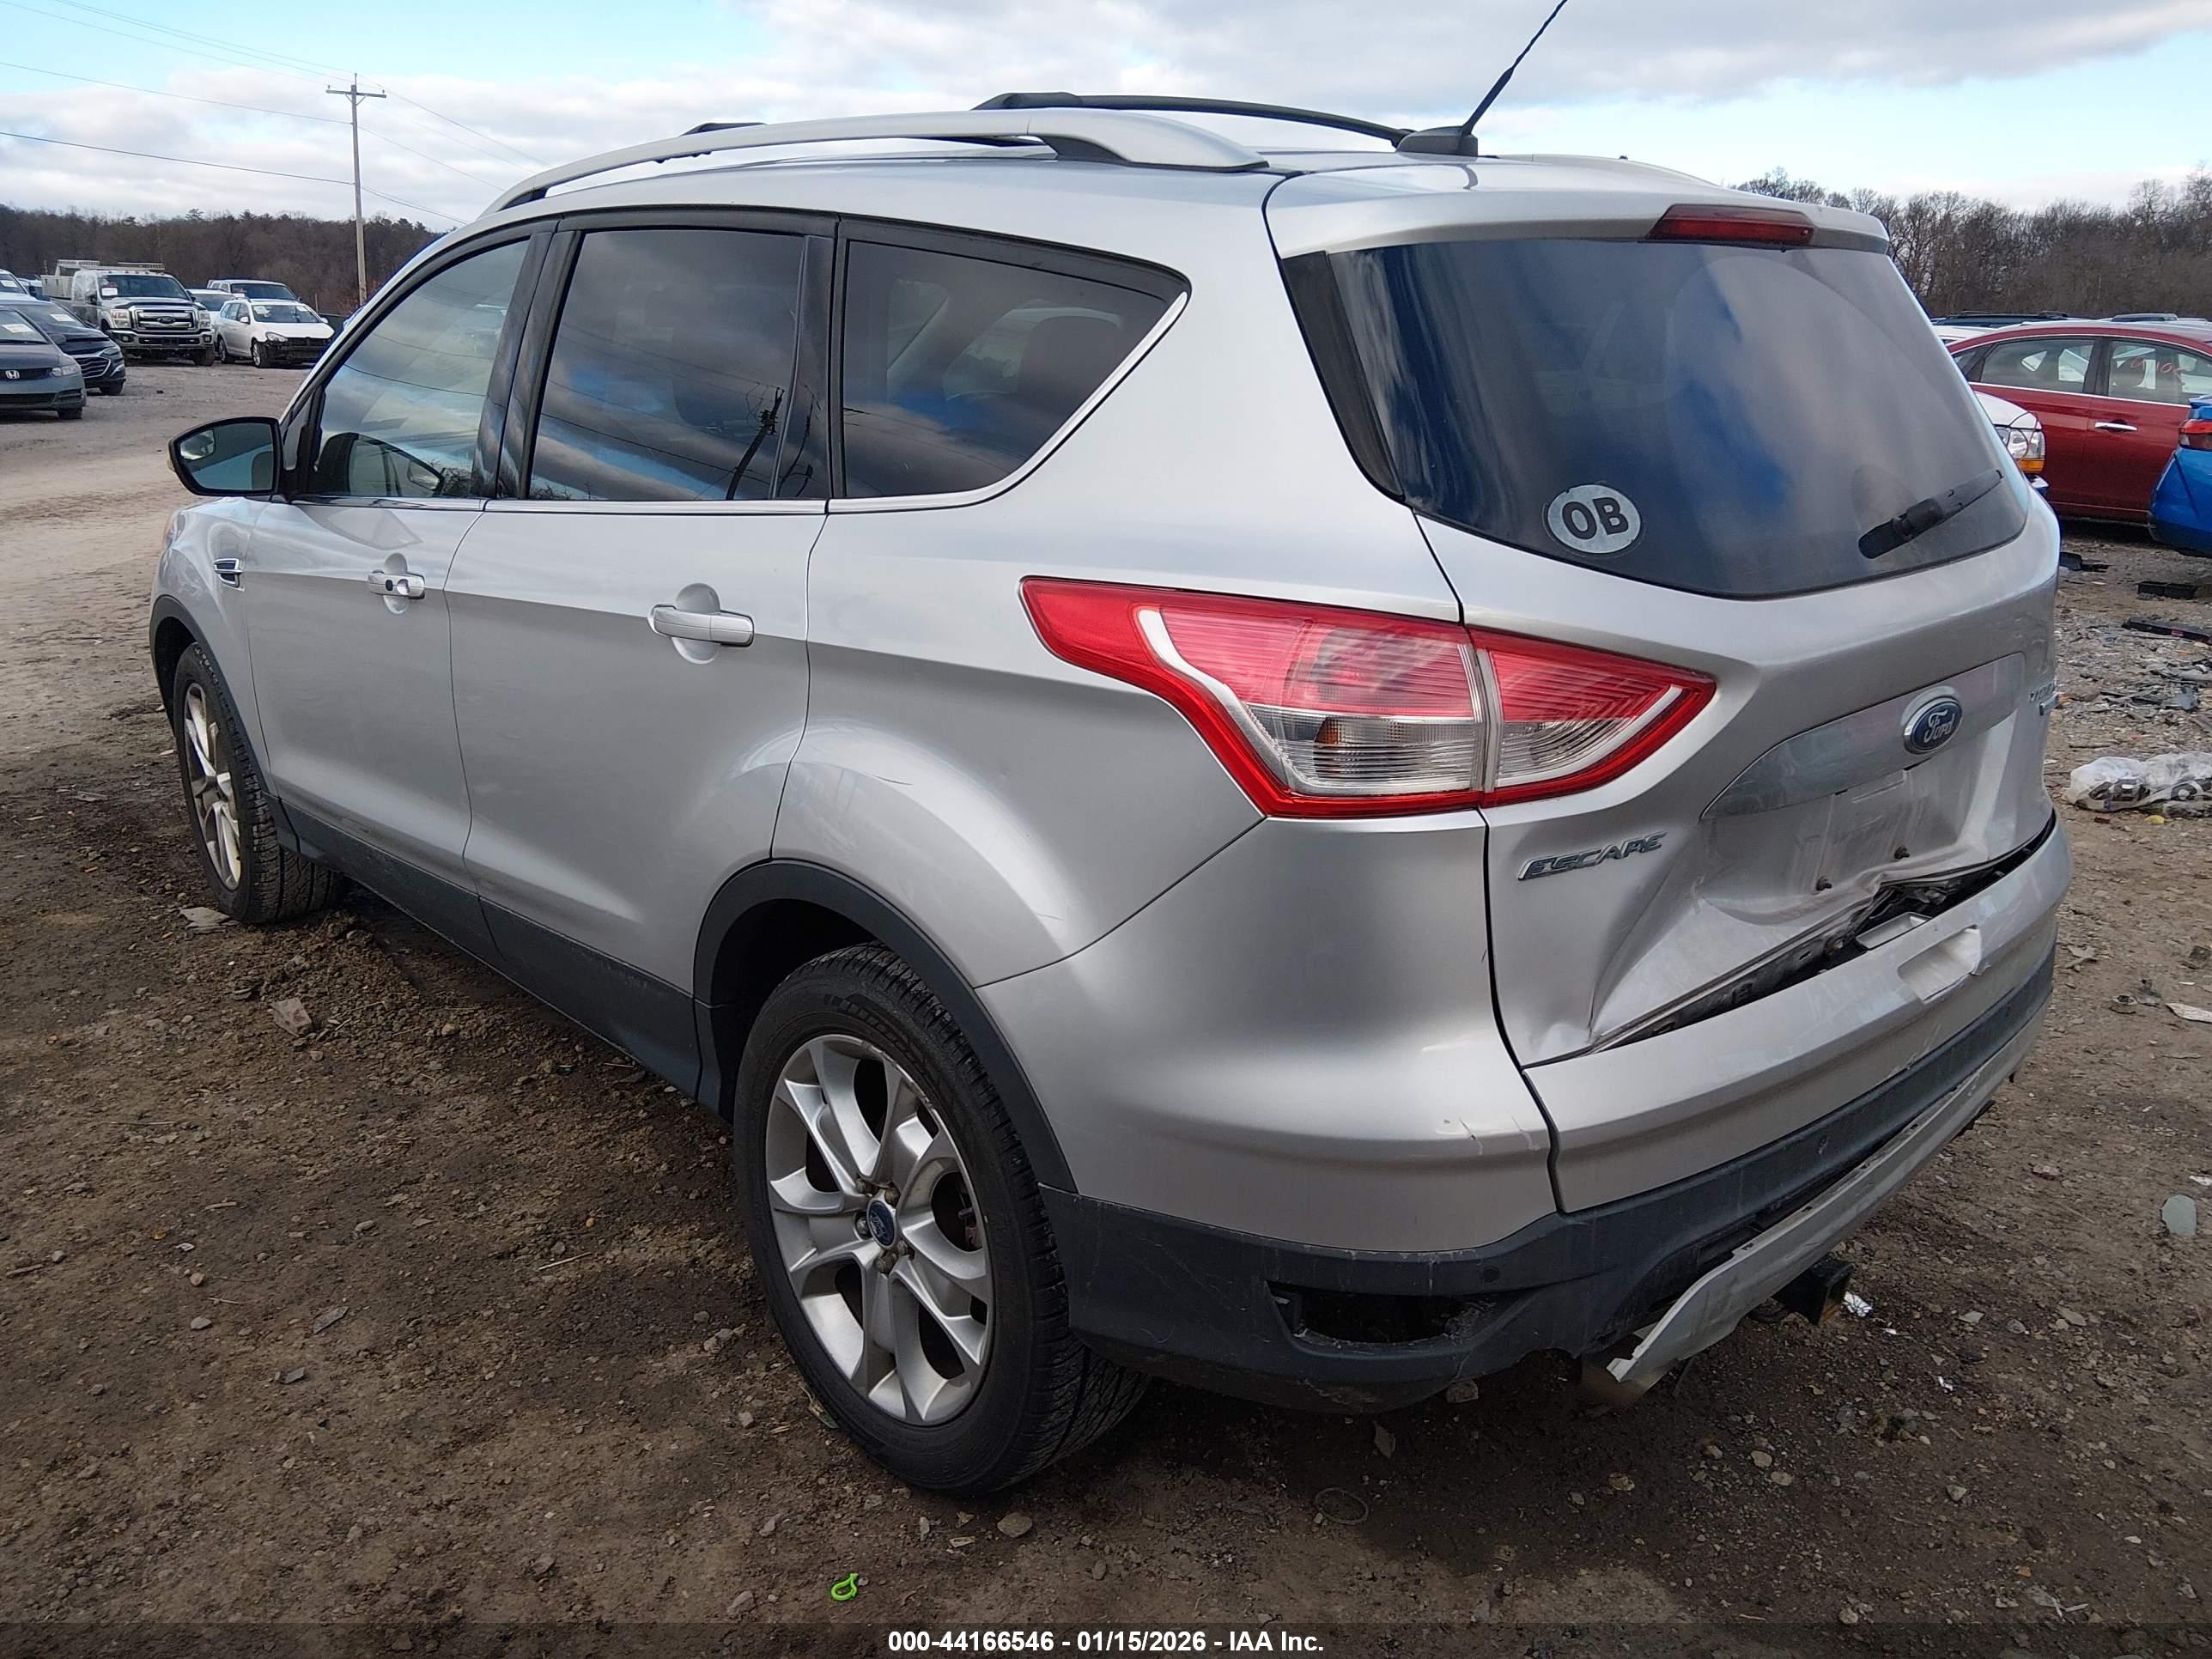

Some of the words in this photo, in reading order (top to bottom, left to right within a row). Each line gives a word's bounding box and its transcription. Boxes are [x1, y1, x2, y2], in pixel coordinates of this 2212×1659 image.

[1562, 496, 1629, 540] OB
[1923, 709, 1956, 744] Ford
[1517, 830, 1668, 881] ESCAPE
